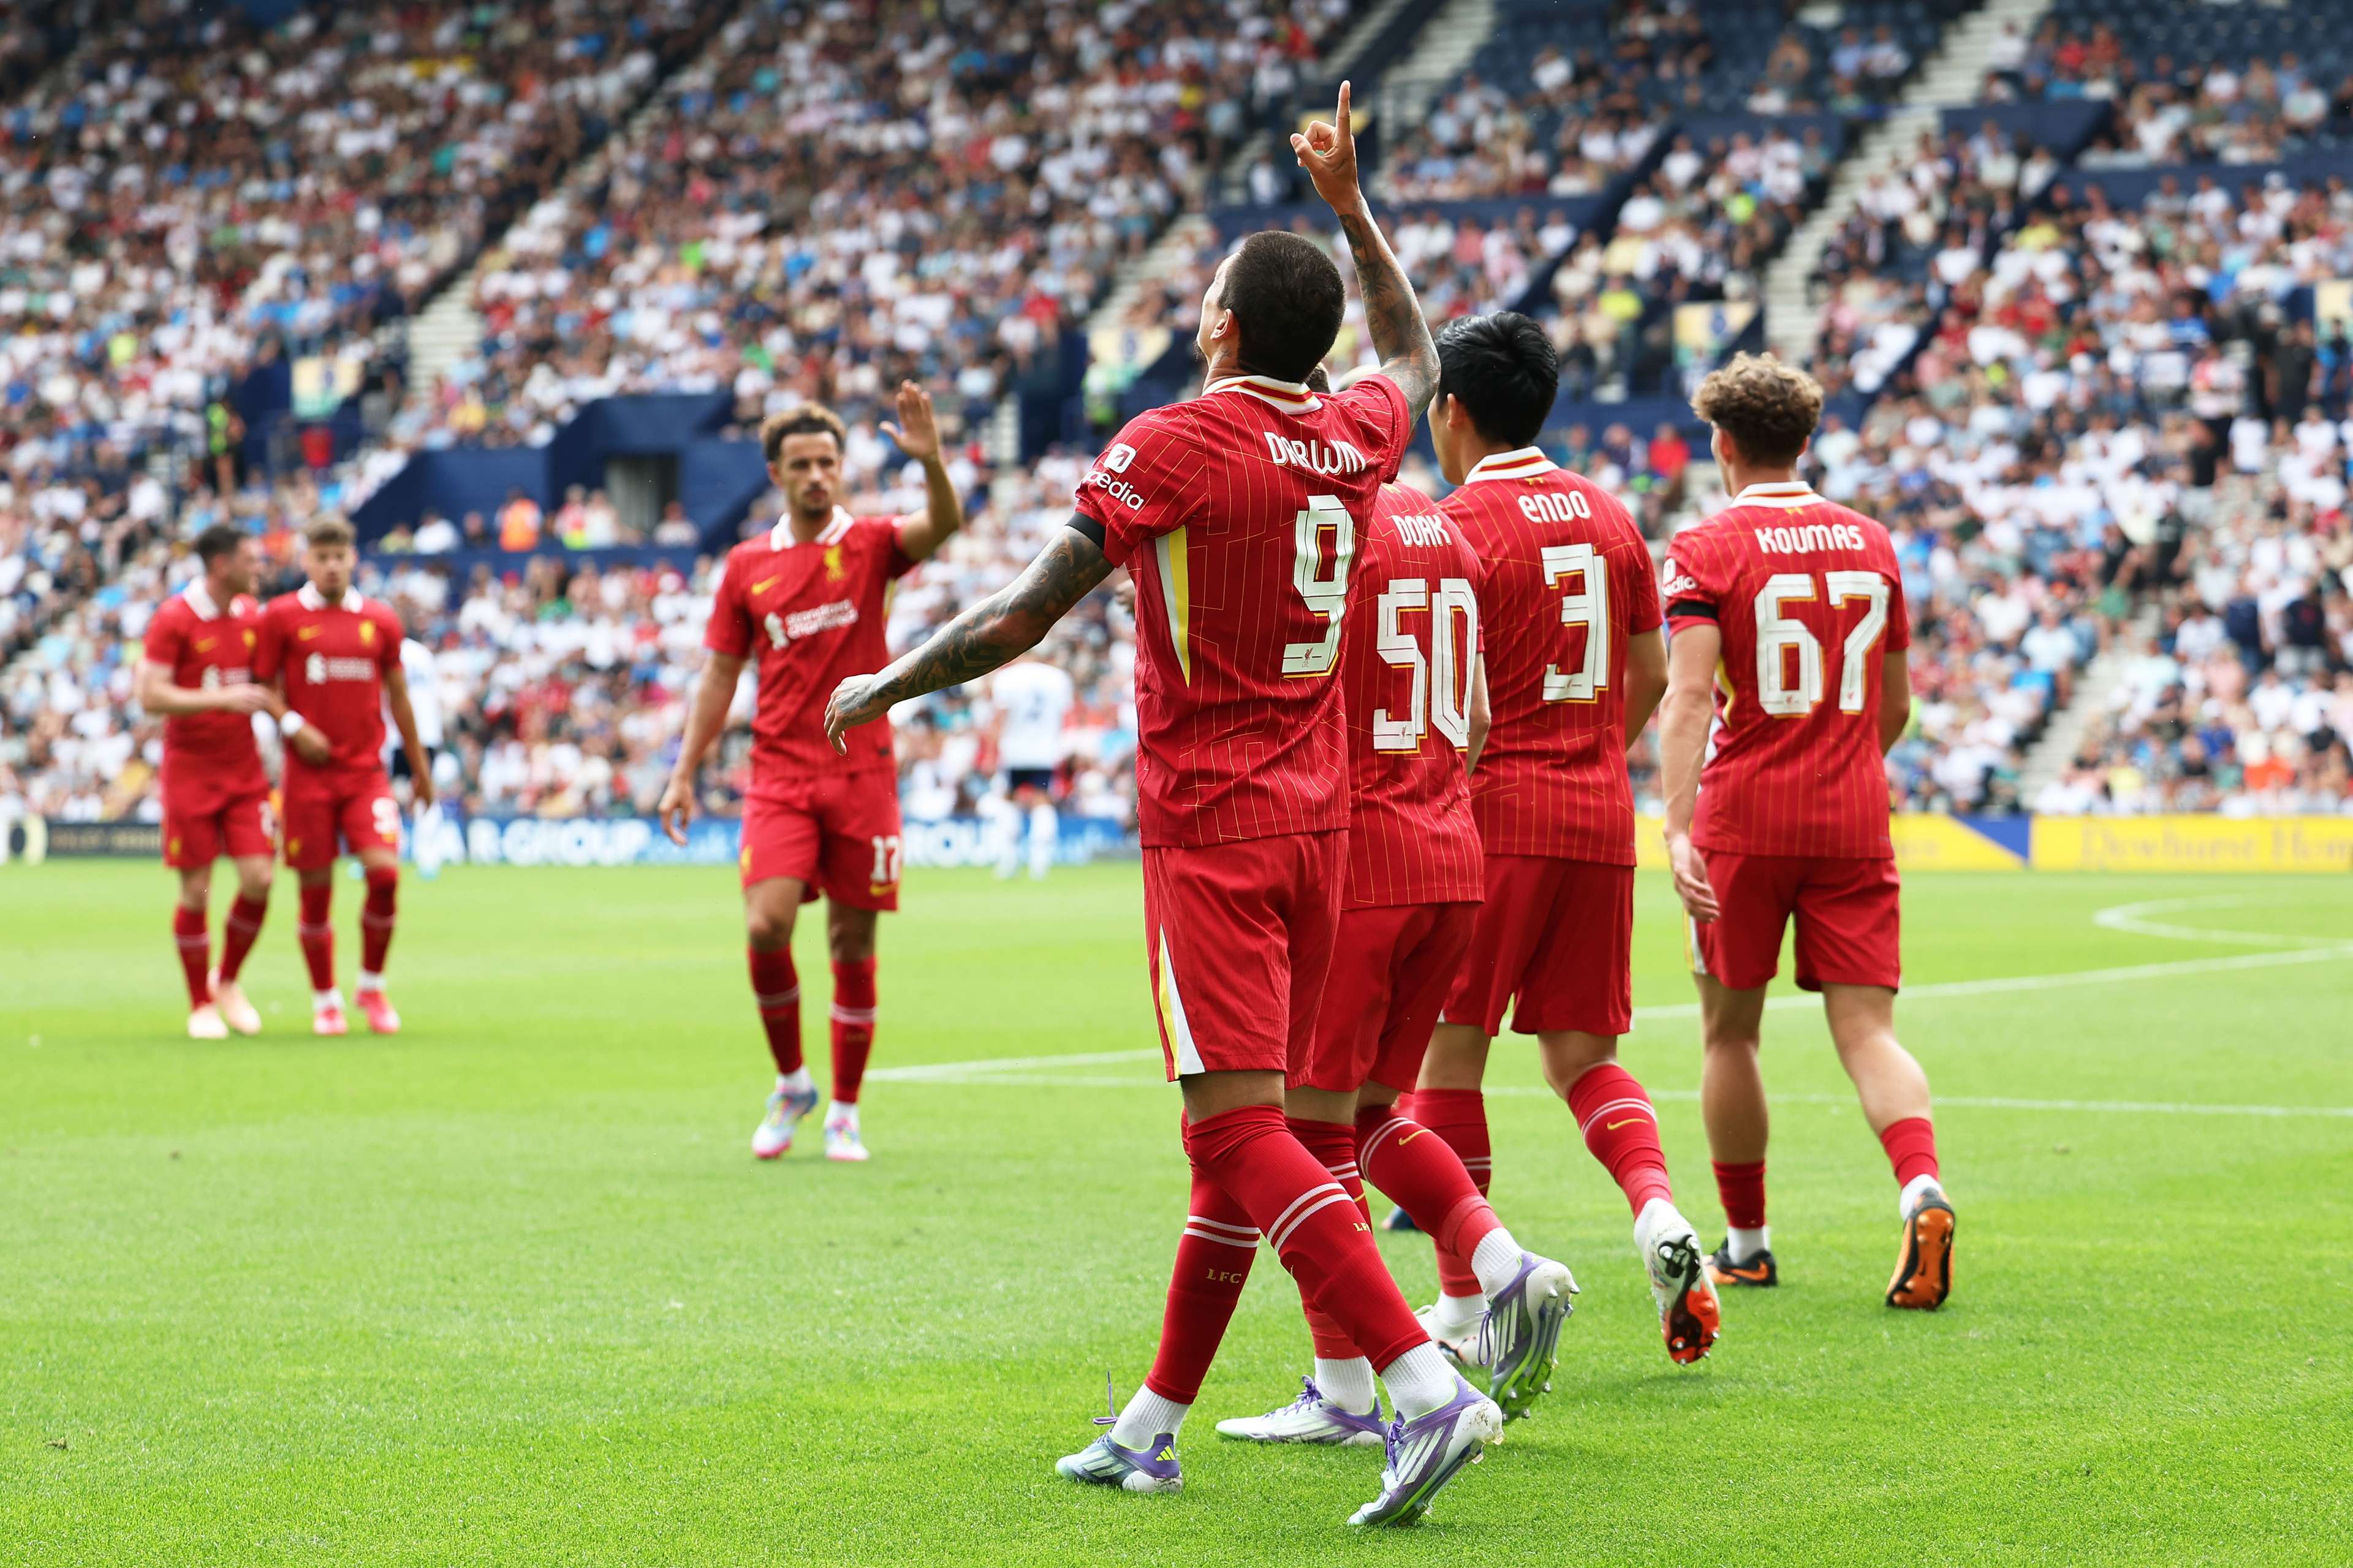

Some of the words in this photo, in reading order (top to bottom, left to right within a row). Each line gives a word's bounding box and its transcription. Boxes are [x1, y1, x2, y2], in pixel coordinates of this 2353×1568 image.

[1264, 431, 1367, 475] DARWIN
[1392, 515, 1452, 547] DOAK
[1754, 525, 1865, 554] KOUMAS
[1281, 494, 1355, 678] 9
[1540, 543, 1609, 704] 3
[1754, 570, 1890, 719] 67
[1373, 578, 1477, 754] 50
[871, 836, 900, 883] 17
[1205, 1268, 1242, 1284] LFC
